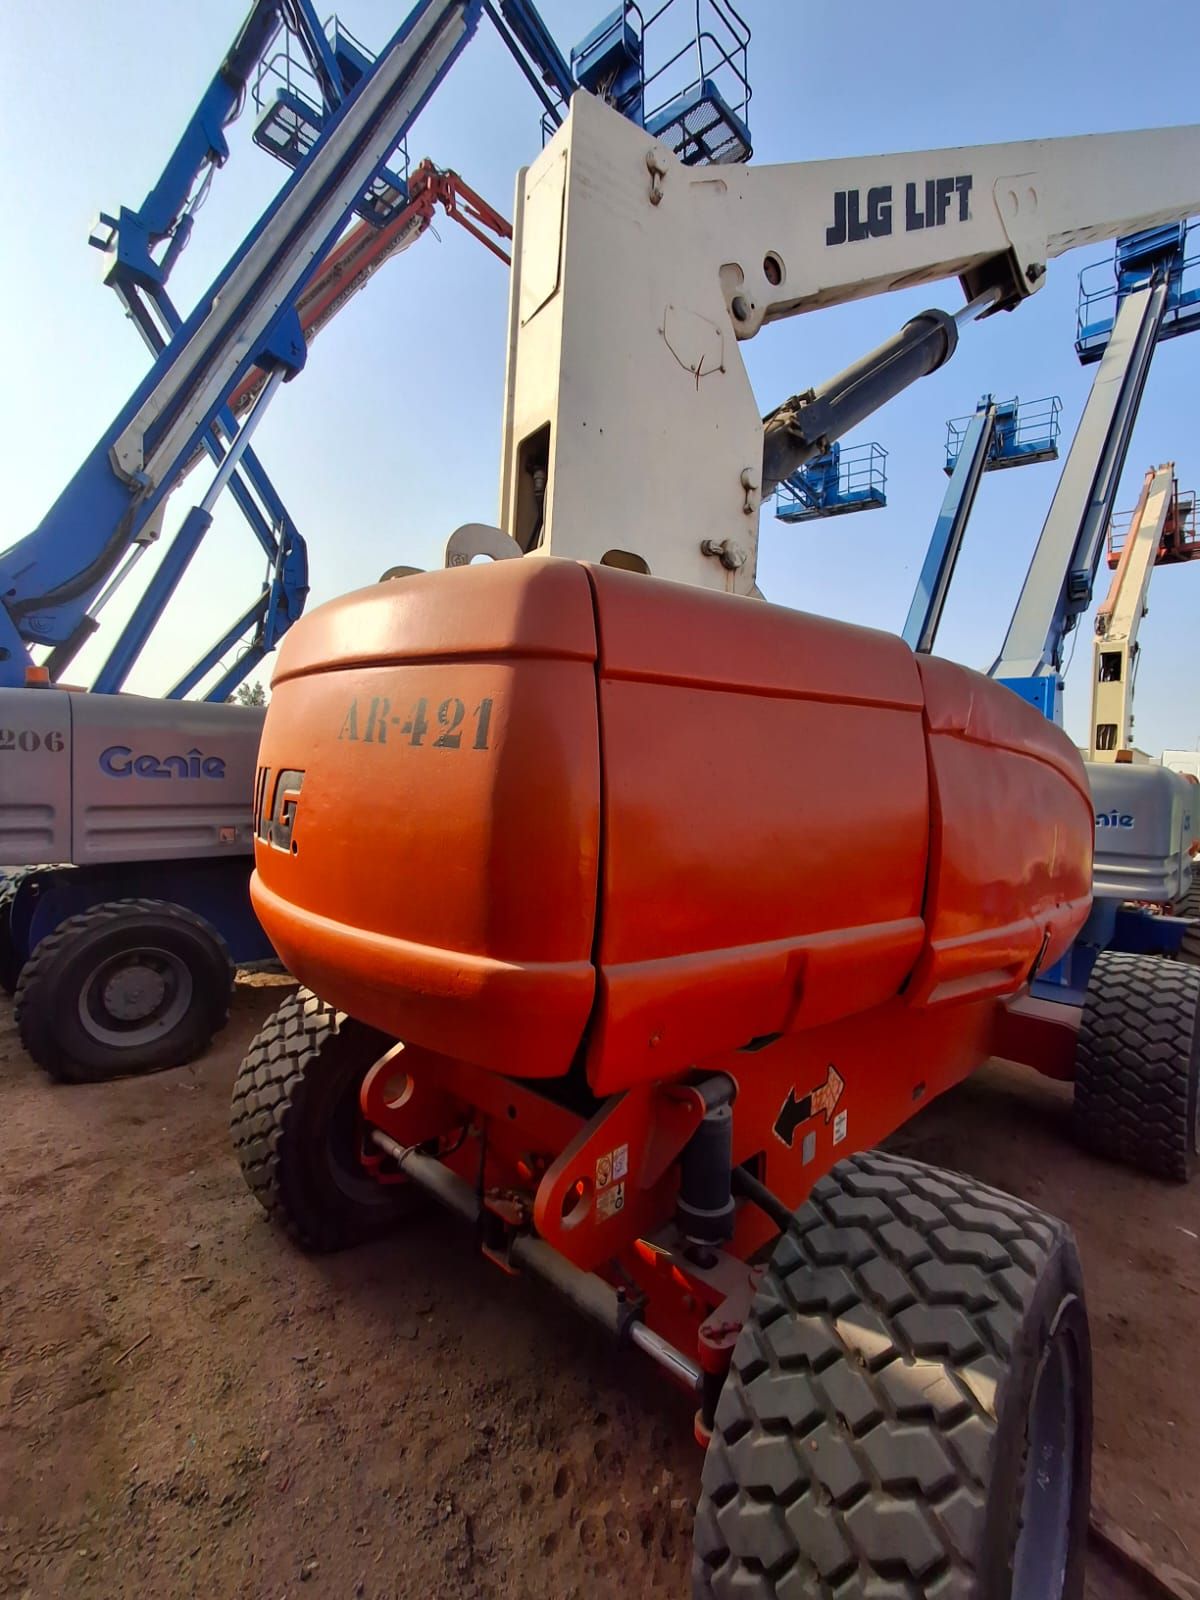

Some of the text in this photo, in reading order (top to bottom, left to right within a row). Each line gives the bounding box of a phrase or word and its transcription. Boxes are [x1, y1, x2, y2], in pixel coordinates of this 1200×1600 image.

[826, 175, 973, 246] JLG LIFT
[337, 697, 493, 750] AR-421
